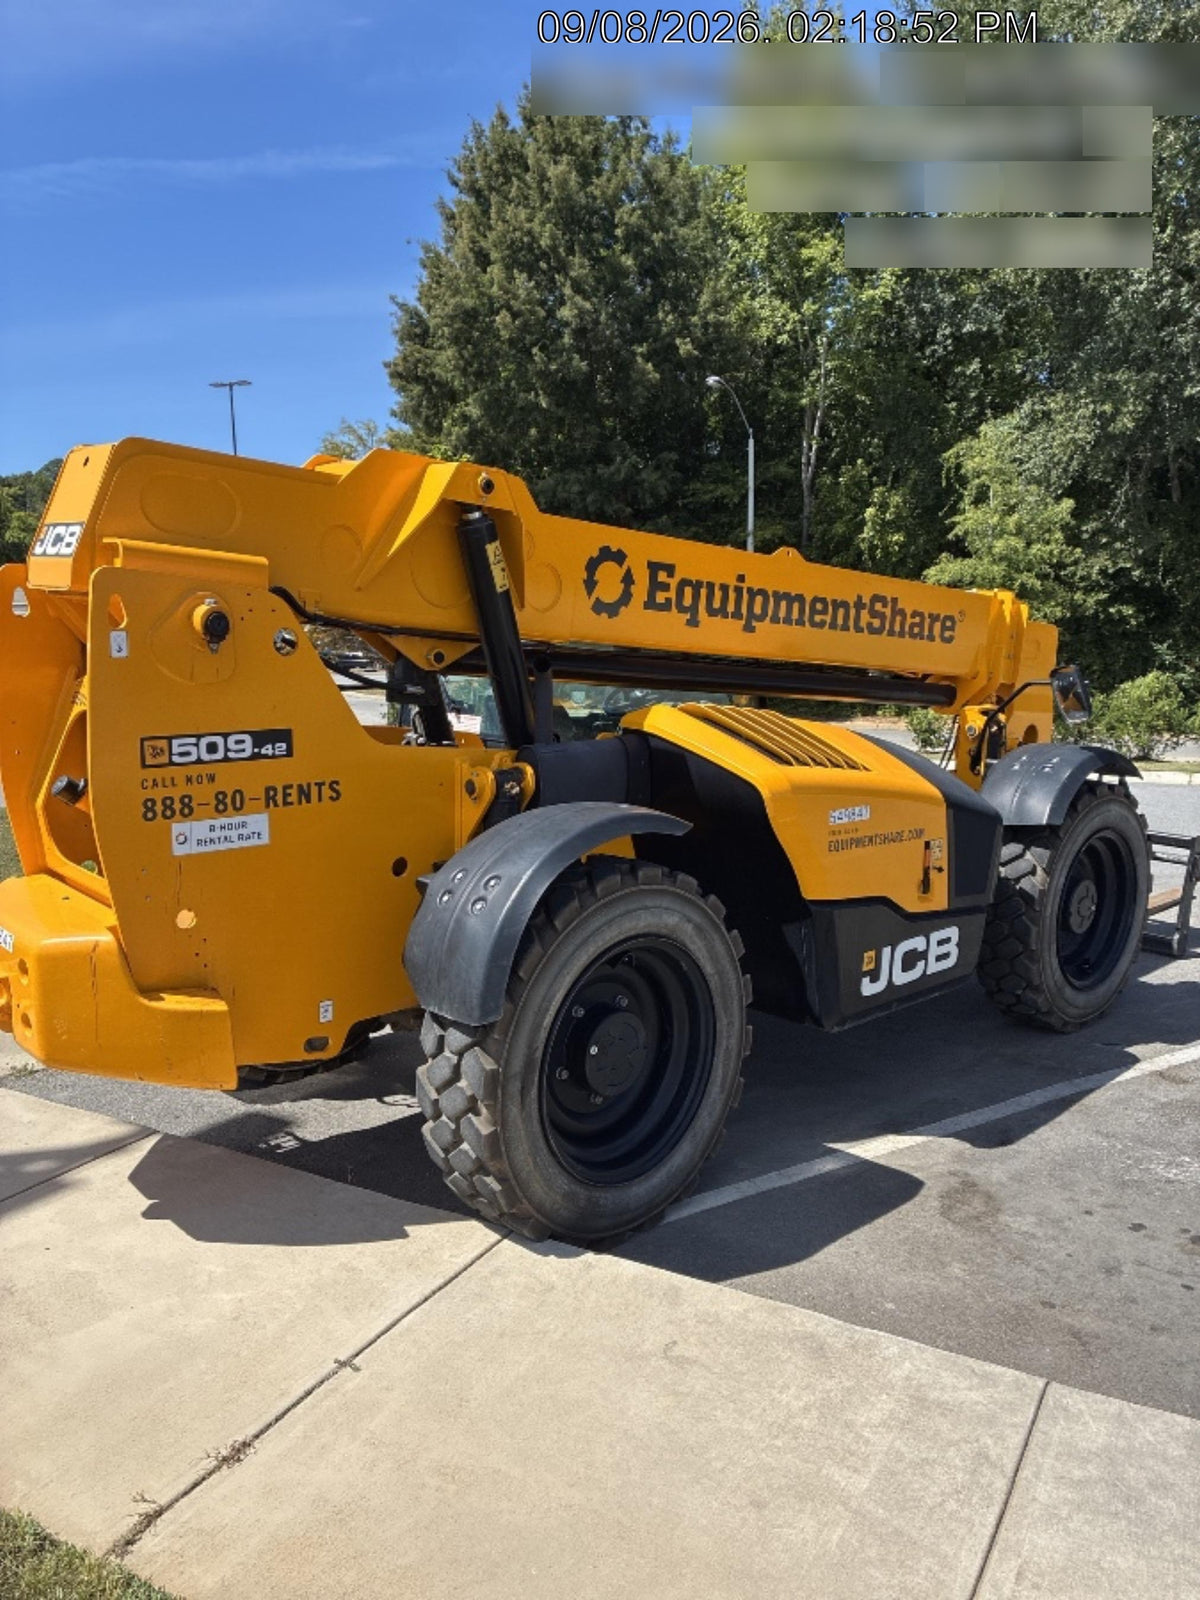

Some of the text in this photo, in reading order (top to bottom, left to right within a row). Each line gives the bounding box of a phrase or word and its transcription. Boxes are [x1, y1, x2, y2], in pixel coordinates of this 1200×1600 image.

[32, 524, 82, 555] JCB
[643, 560, 957, 644] EquipmentShare
[141, 773, 216, 790] CALL NOW
[142, 780, 342, 822] 888-80-RENTS
[196, 831, 263, 847] RENTAL RATE
[860, 925, 960, 996] JCB
